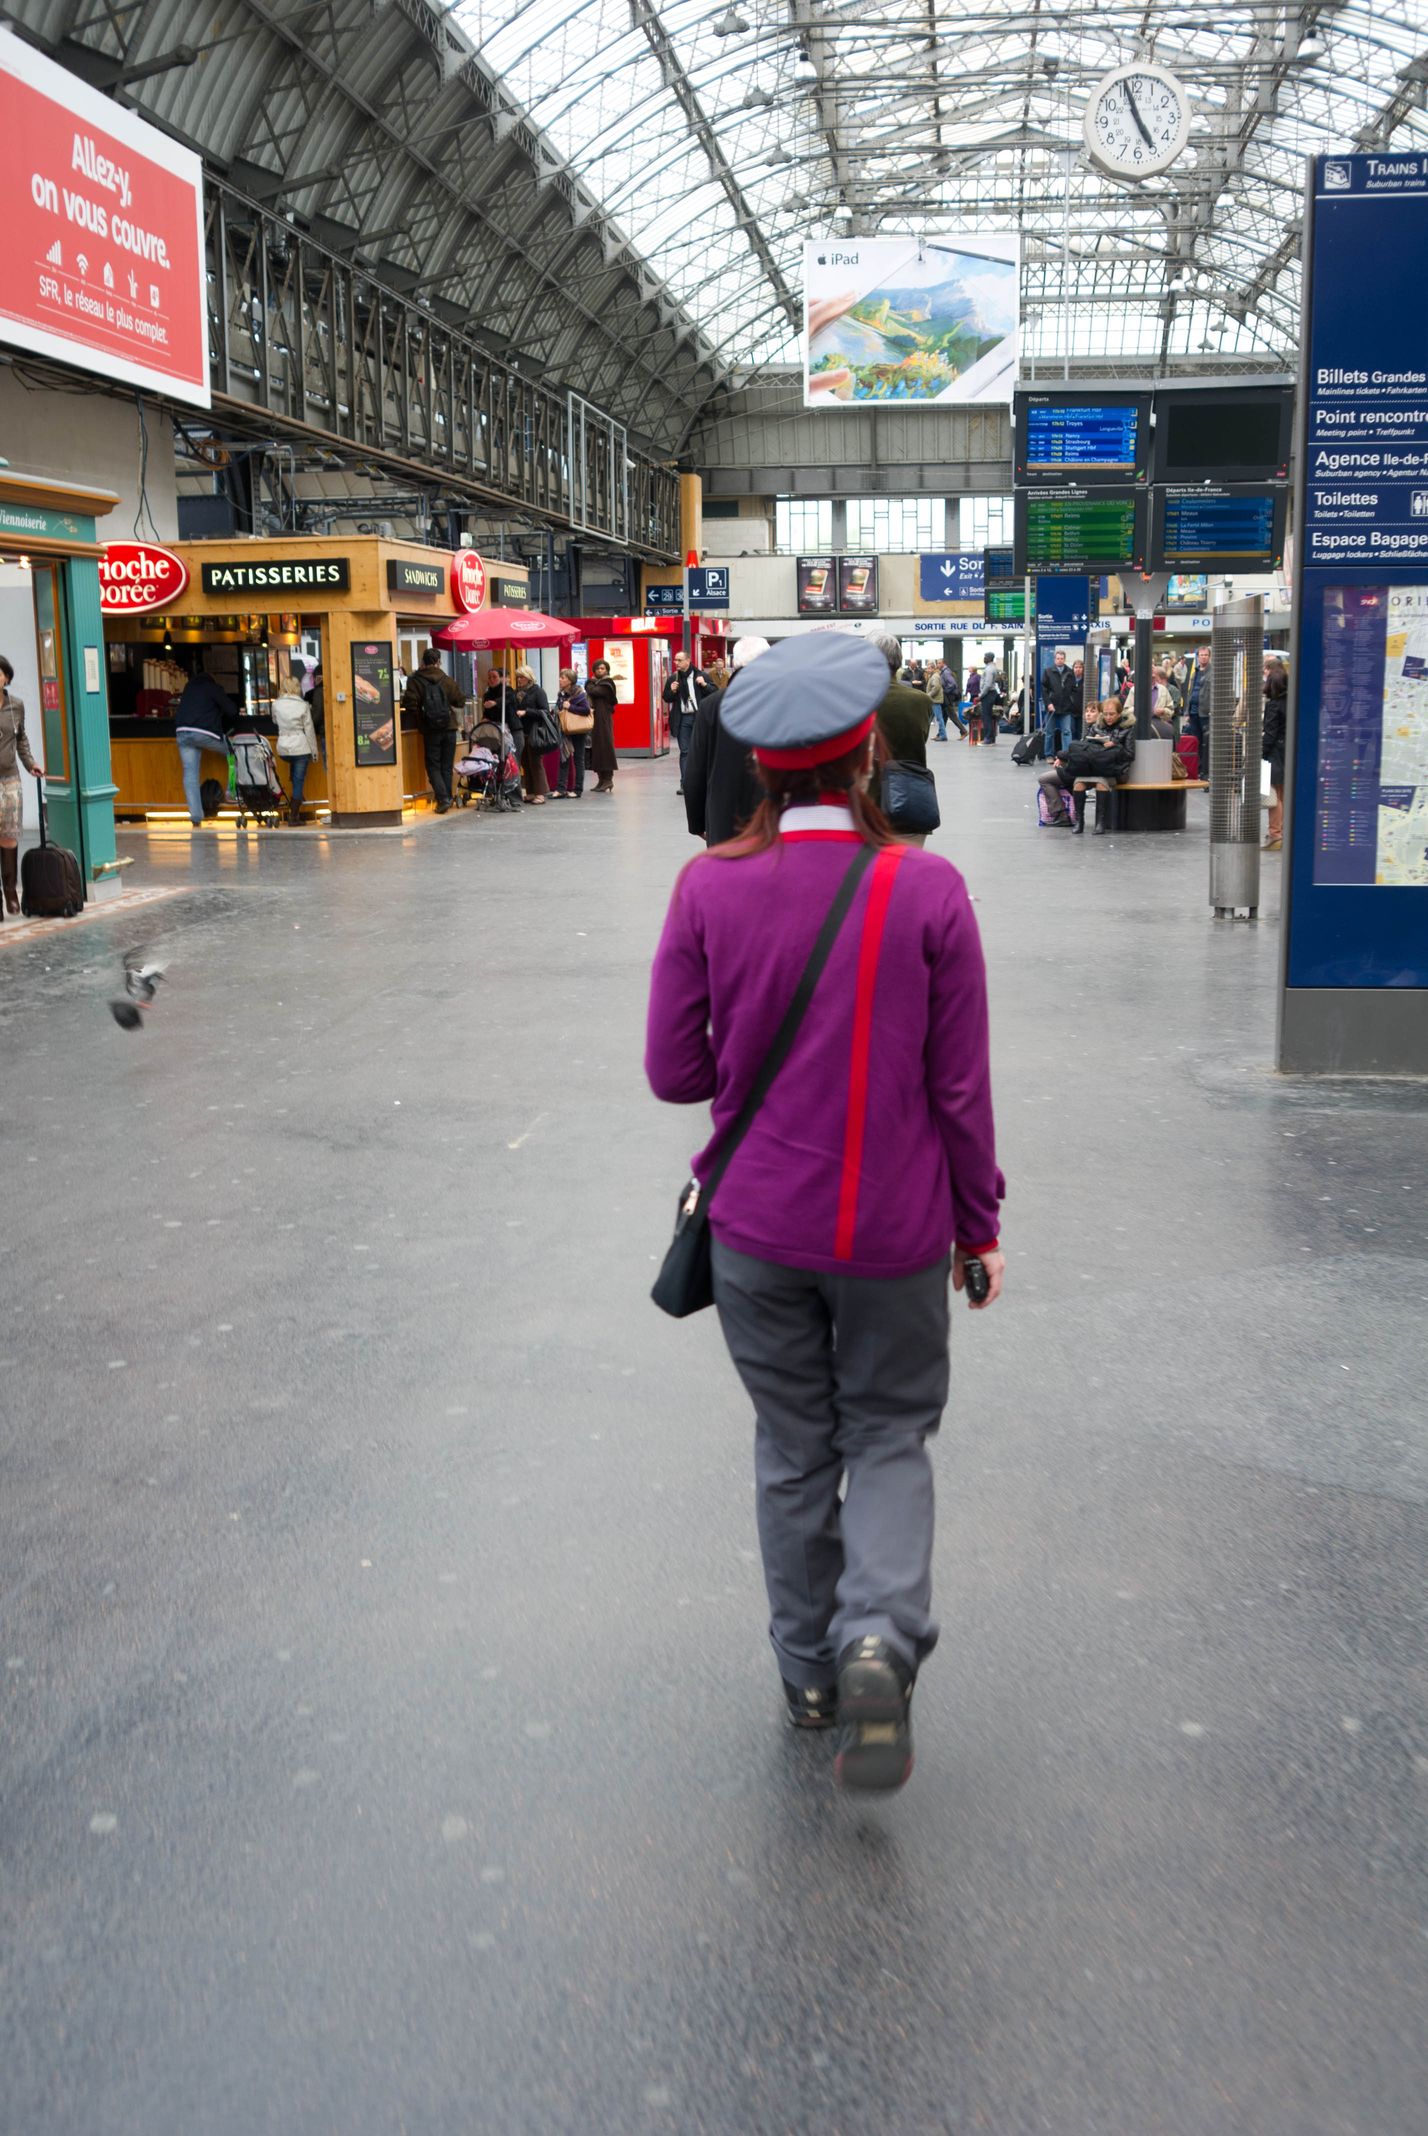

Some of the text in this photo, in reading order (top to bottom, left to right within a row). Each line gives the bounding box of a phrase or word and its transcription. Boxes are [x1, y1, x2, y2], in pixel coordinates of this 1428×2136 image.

[1132, 81, 1143, 94] 12
[1150, 83, 1154, 96] 1
[1105, 99, 1116, 111] 10
[1160, 96, 1170, 108] 2
[1100, 116, 1109, 128] 9
[1168, 112, 1177, 125] 3
[1107, 132, 1116, 145] 8
[1161, 129, 1170, 140] 4
[1120, 144, 1128, 157] 7
[1133, 147, 1143, 159] 6
[1149, 143, 1158, 155] 5
[72, 133, 132, 207] Allez-y,
[1366, 179, 1426, 189] Suburban trains
[31, 173, 171, 270] on vous couvre.
[831, 253, 859, 265] iPad
[39, 274, 62, 305] SFR,
[63, 286, 73, 307] le
[75, 291, 104, 320] réseau
[106, 305, 115, 323] le
[116, 311, 134, 333] plus
[135, 316, 170, 345] complet.
[1317, 368, 1426, 384] Billets Grandes
[1317, 386, 1428, 395] Mainlines tickets Fahrkarten
[1316, 410, 1356, 424] Point
[1316, 428, 1415, 437] Meeting point Treffpunkt
[1315, 451, 1380, 469] Agence
[1315, 469, 1353, 478] Suburban
[1354, 470, 1382, 478] agency
[1386, 469, 1419, 477] Agentur
[1314, 492, 1379, 506] Toilettes
[1314, 510, 1375, 518] Toilets Toiletten
[1312, 532, 1367, 548] Espace
[1312, 551, 1345, 559] Luggage
[211, 565, 340, 586] PATISSERIES
[503, 584, 526, 599] PATISSERIES
[706, 589, 726, 597] Alsace
[915, 623, 946, 631] SORTIE
[973, 622, 985, 630] DU
